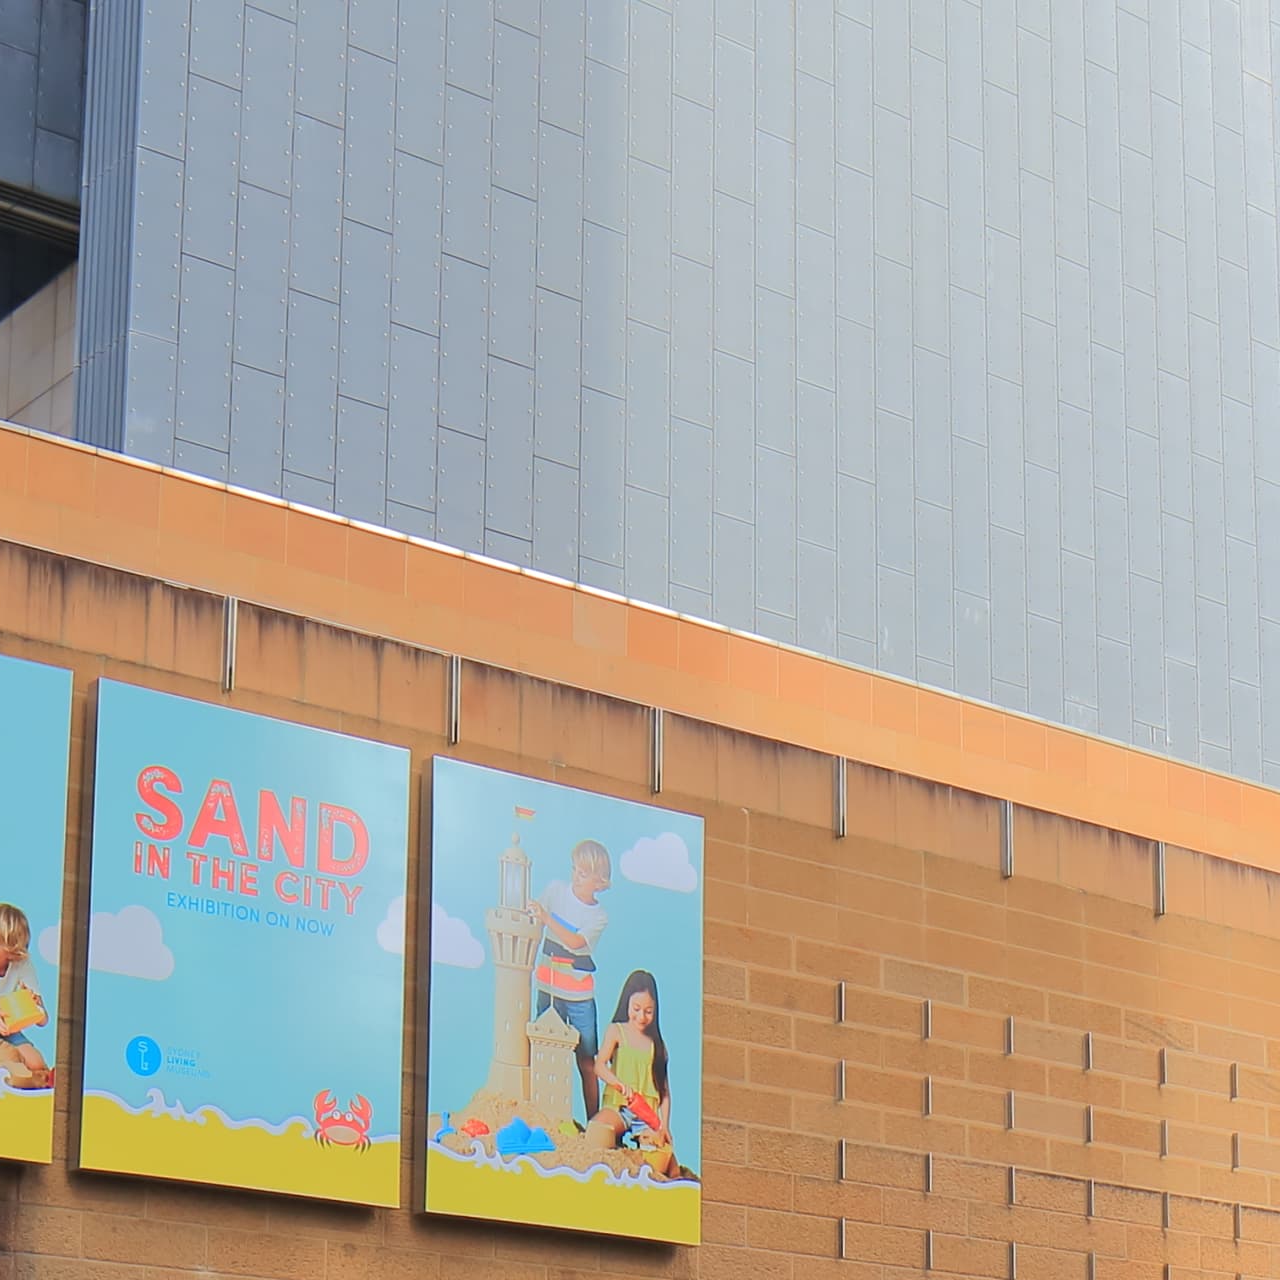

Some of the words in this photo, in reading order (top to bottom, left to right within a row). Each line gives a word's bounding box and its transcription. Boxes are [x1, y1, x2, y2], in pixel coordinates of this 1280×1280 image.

[135, 764, 370, 877] SAND
[132, 840, 171, 880] IN
[186, 851, 260, 897] THE
[274, 871, 364, 916] CITY
[167, 891, 261, 923] EXHIBITION
[265, 911, 290, 929] ON
[296, 918, 335, 937] NOW
[166, 1055, 196, 1068] LIVING
